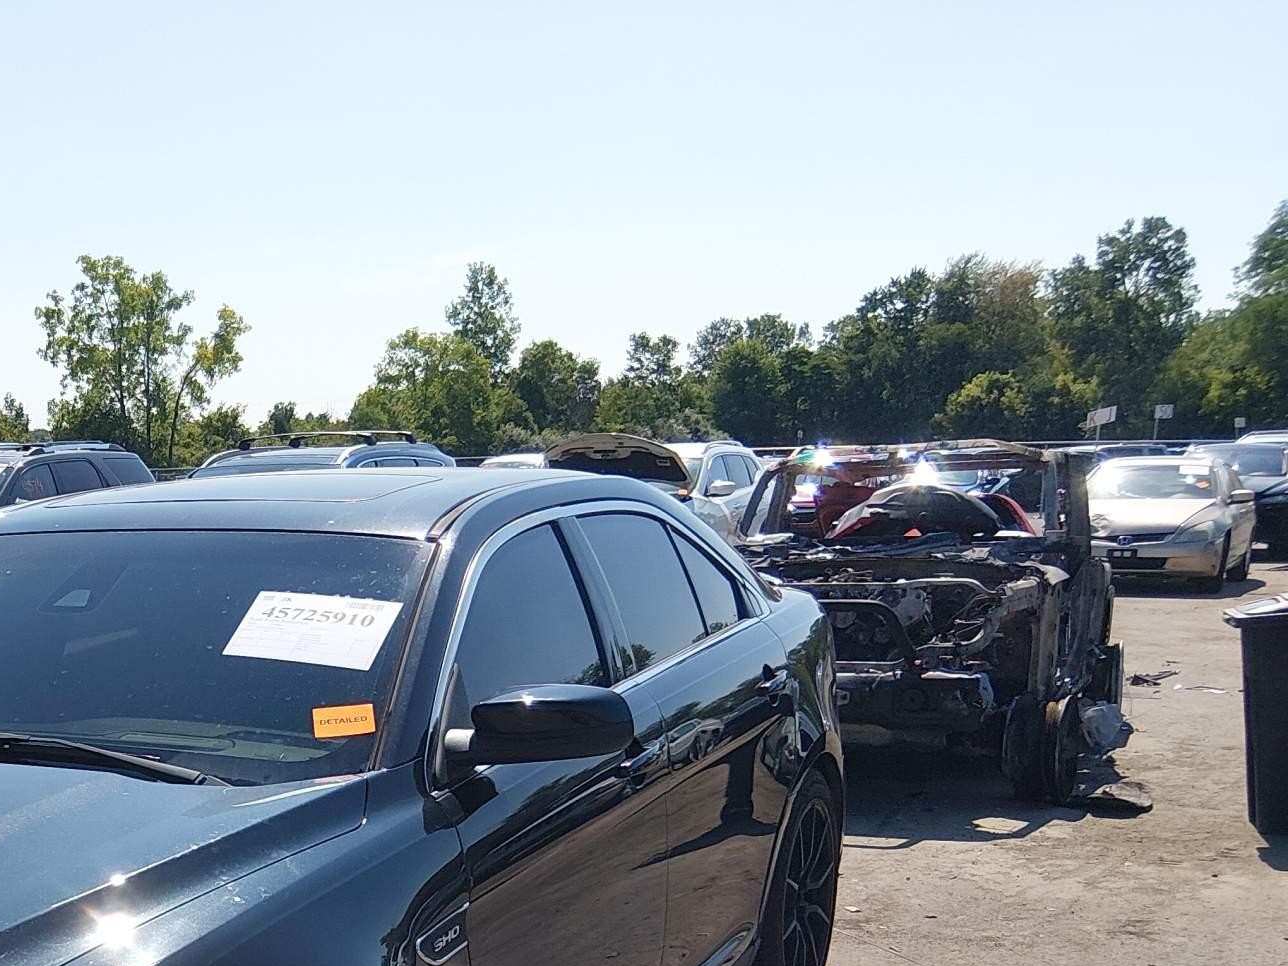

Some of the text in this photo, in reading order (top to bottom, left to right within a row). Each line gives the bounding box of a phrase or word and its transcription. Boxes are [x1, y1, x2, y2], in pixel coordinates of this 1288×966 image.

[261, 605, 376, 628] 45725910
[319, 715, 368, 726] DETAILED
[433, 924, 460, 953] SHO
